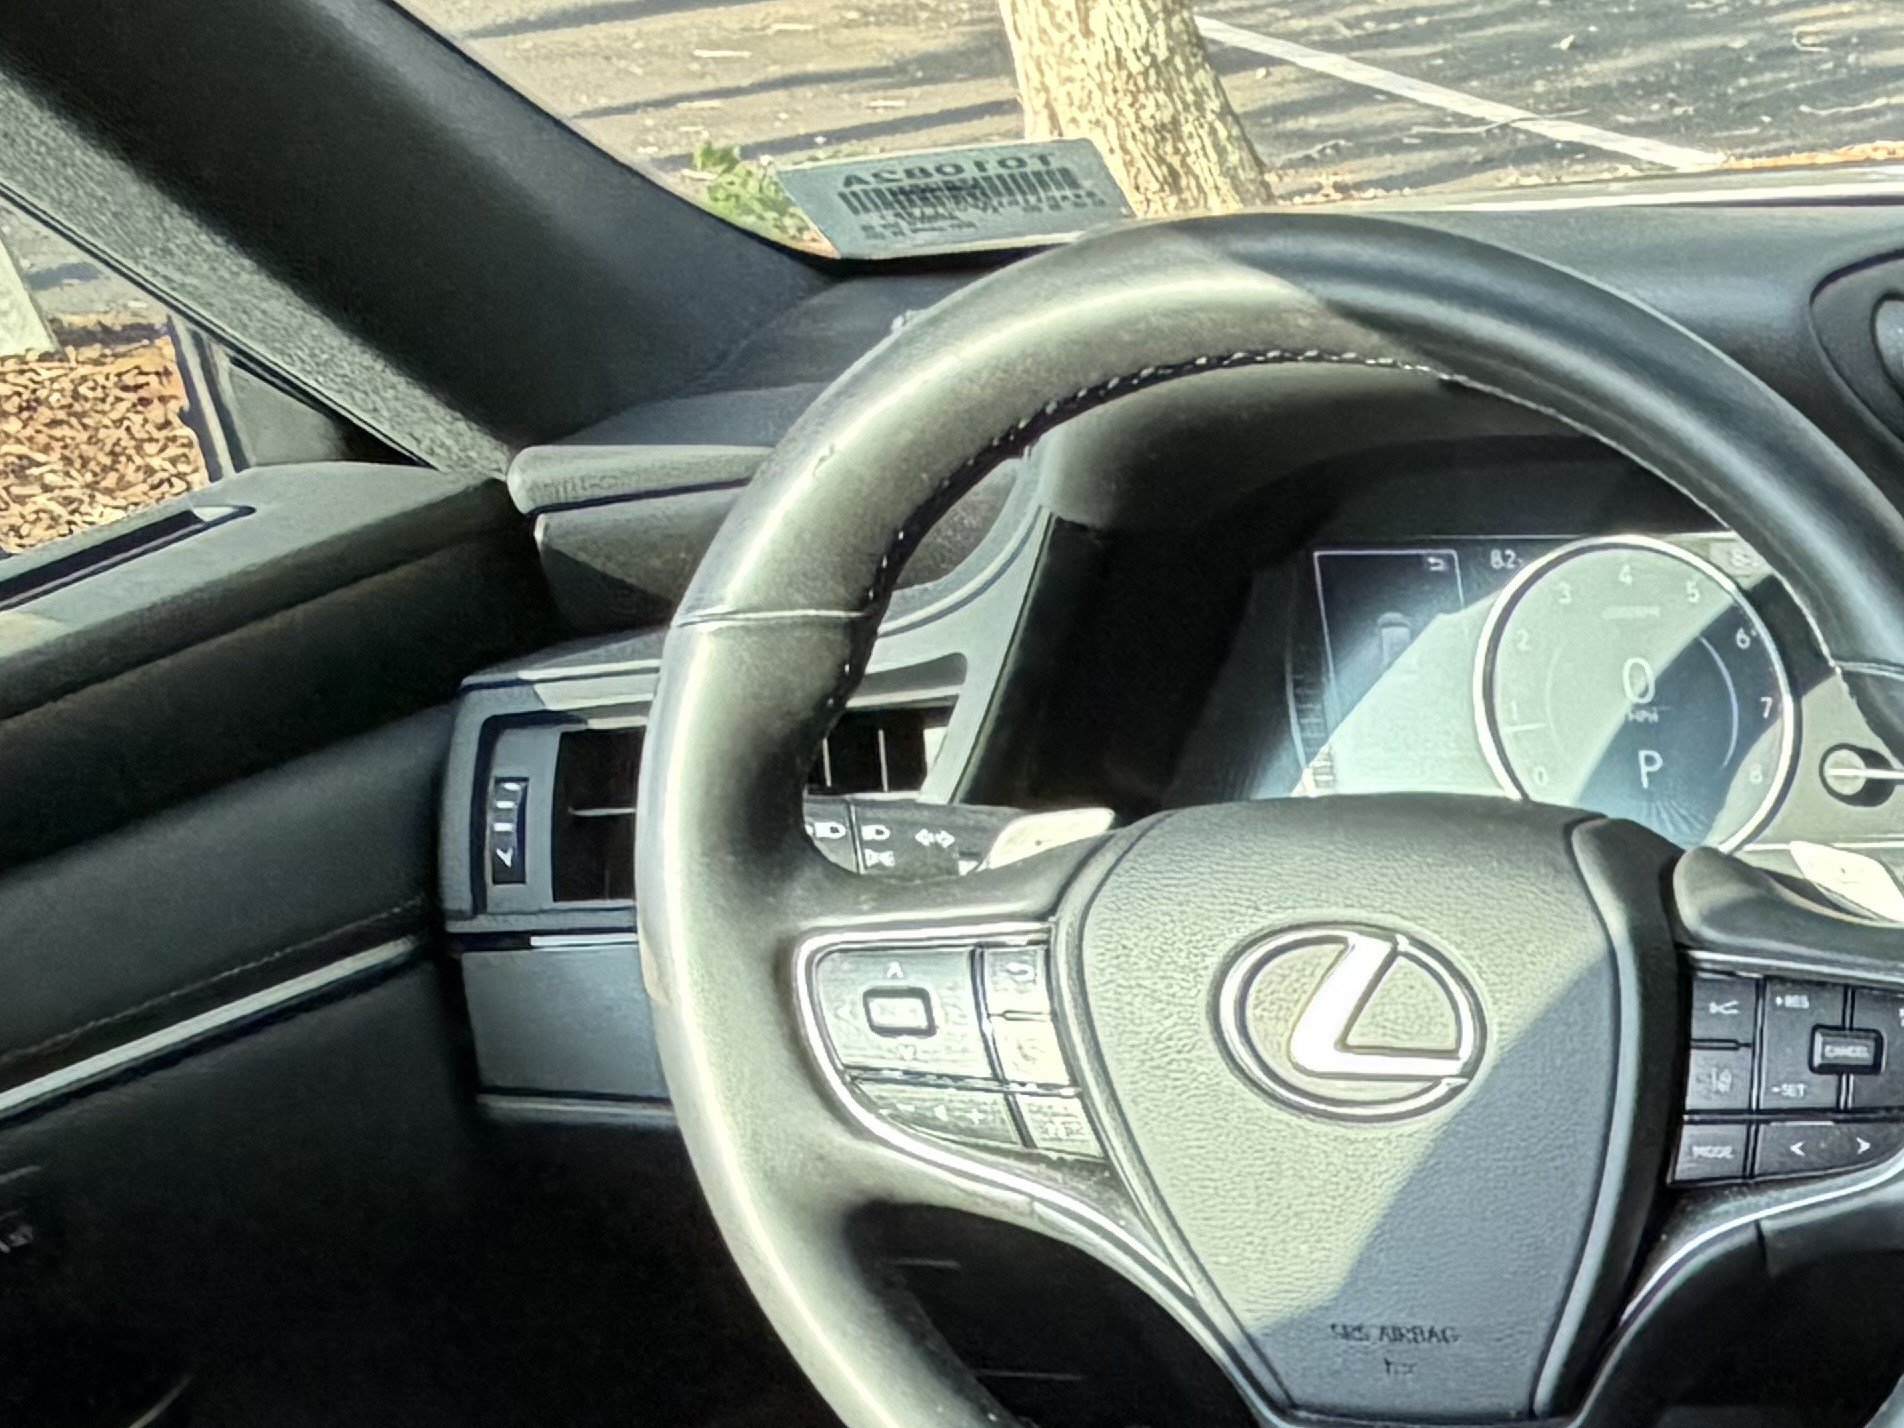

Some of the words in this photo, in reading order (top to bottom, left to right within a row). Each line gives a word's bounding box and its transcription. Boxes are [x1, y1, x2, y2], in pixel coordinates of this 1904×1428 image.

[1618, 564, 1633, 586] 4
[1558, 582, 1572, 605] 3
[1686, 580, 1700, 604] 5
[1517, 629, 1530, 651] 2
[1735, 627, 1751, 650] 6
[1623, 657, 1656, 704] 0
[1760, 696, 1773, 719] 7
[1638, 749, 1664, 790] P
